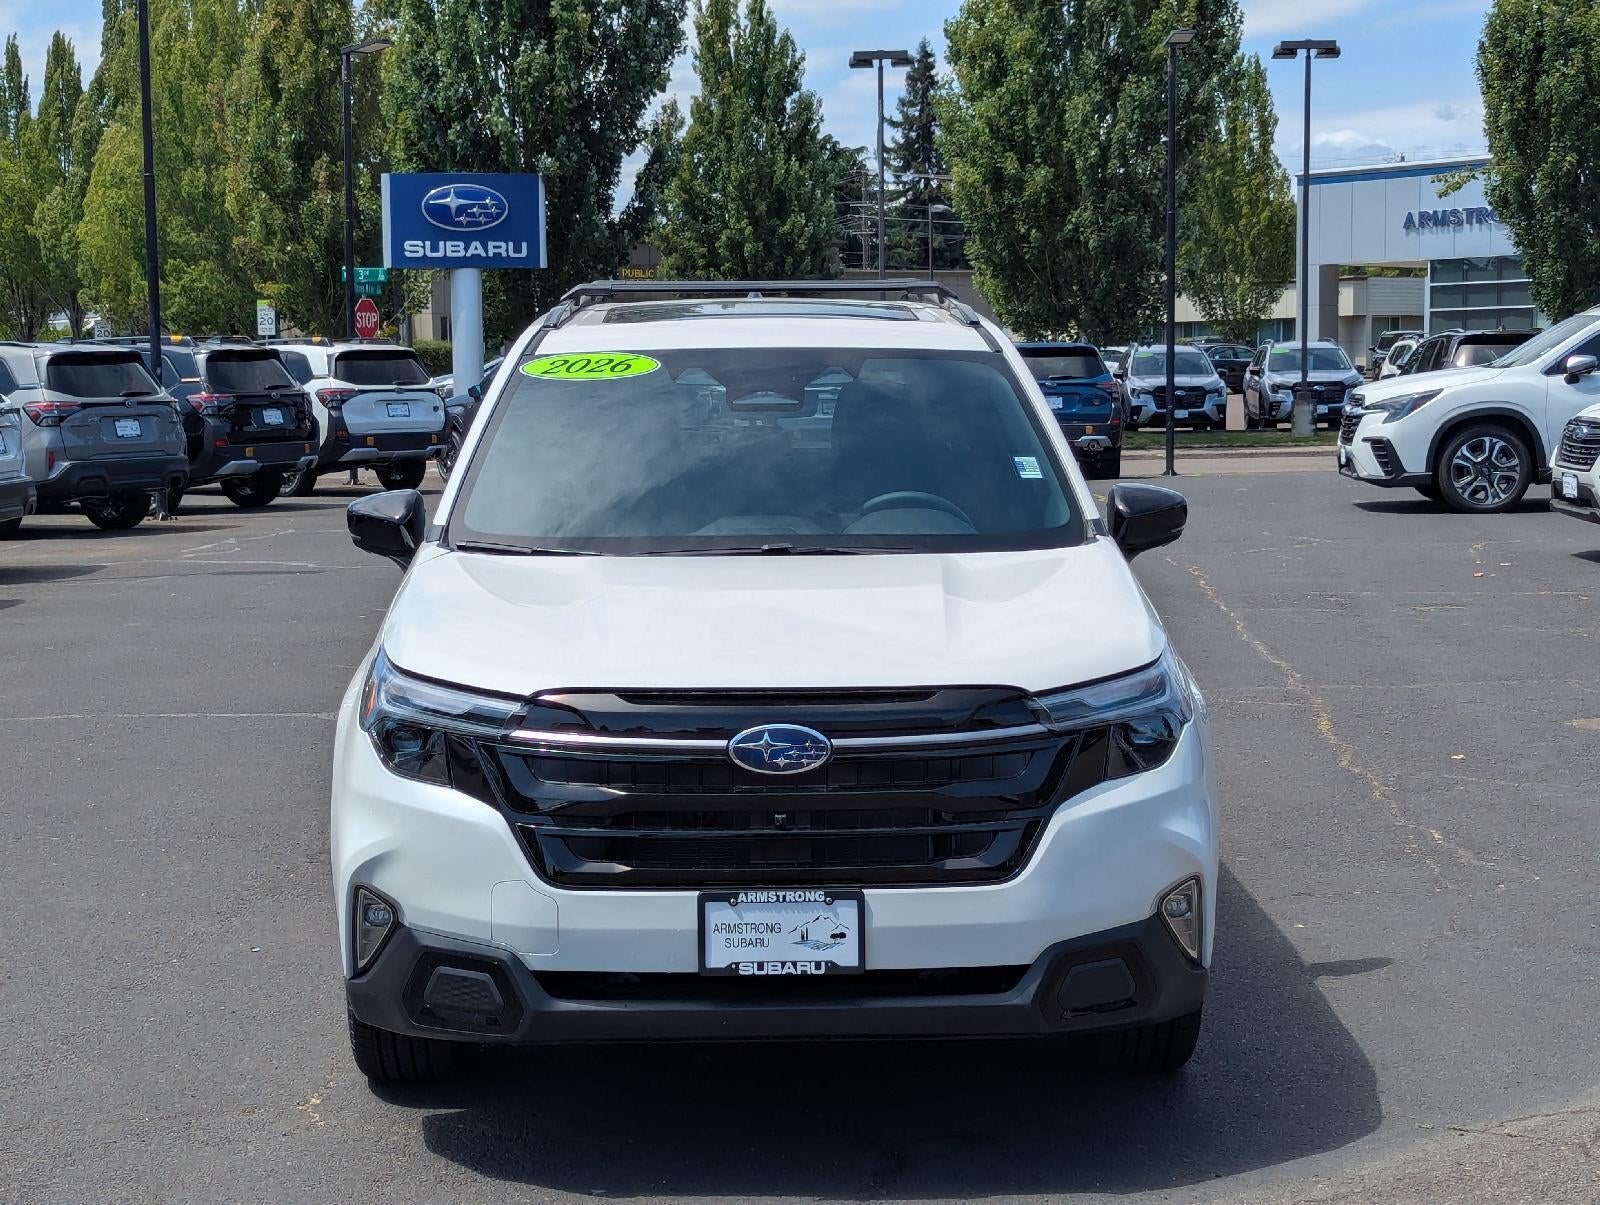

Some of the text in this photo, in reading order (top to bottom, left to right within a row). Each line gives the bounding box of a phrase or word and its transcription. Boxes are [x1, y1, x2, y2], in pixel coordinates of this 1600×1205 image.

[403, 241, 528, 258] SUBARU
[622, 268, 654, 278] PUBLIC
[259, 316, 274, 326] 20
[356, 312, 378, 329] STOP
[96, 329, 111, 338] 20
[540, 357, 641, 375] 2026
[736, 890, 825, 903] ARMSTRONG
[712, 922, 782, 935] ARMSTRONG
[724, 937, 770, 949] SUBARU
[738, 961, 826, 976] SUBARU
